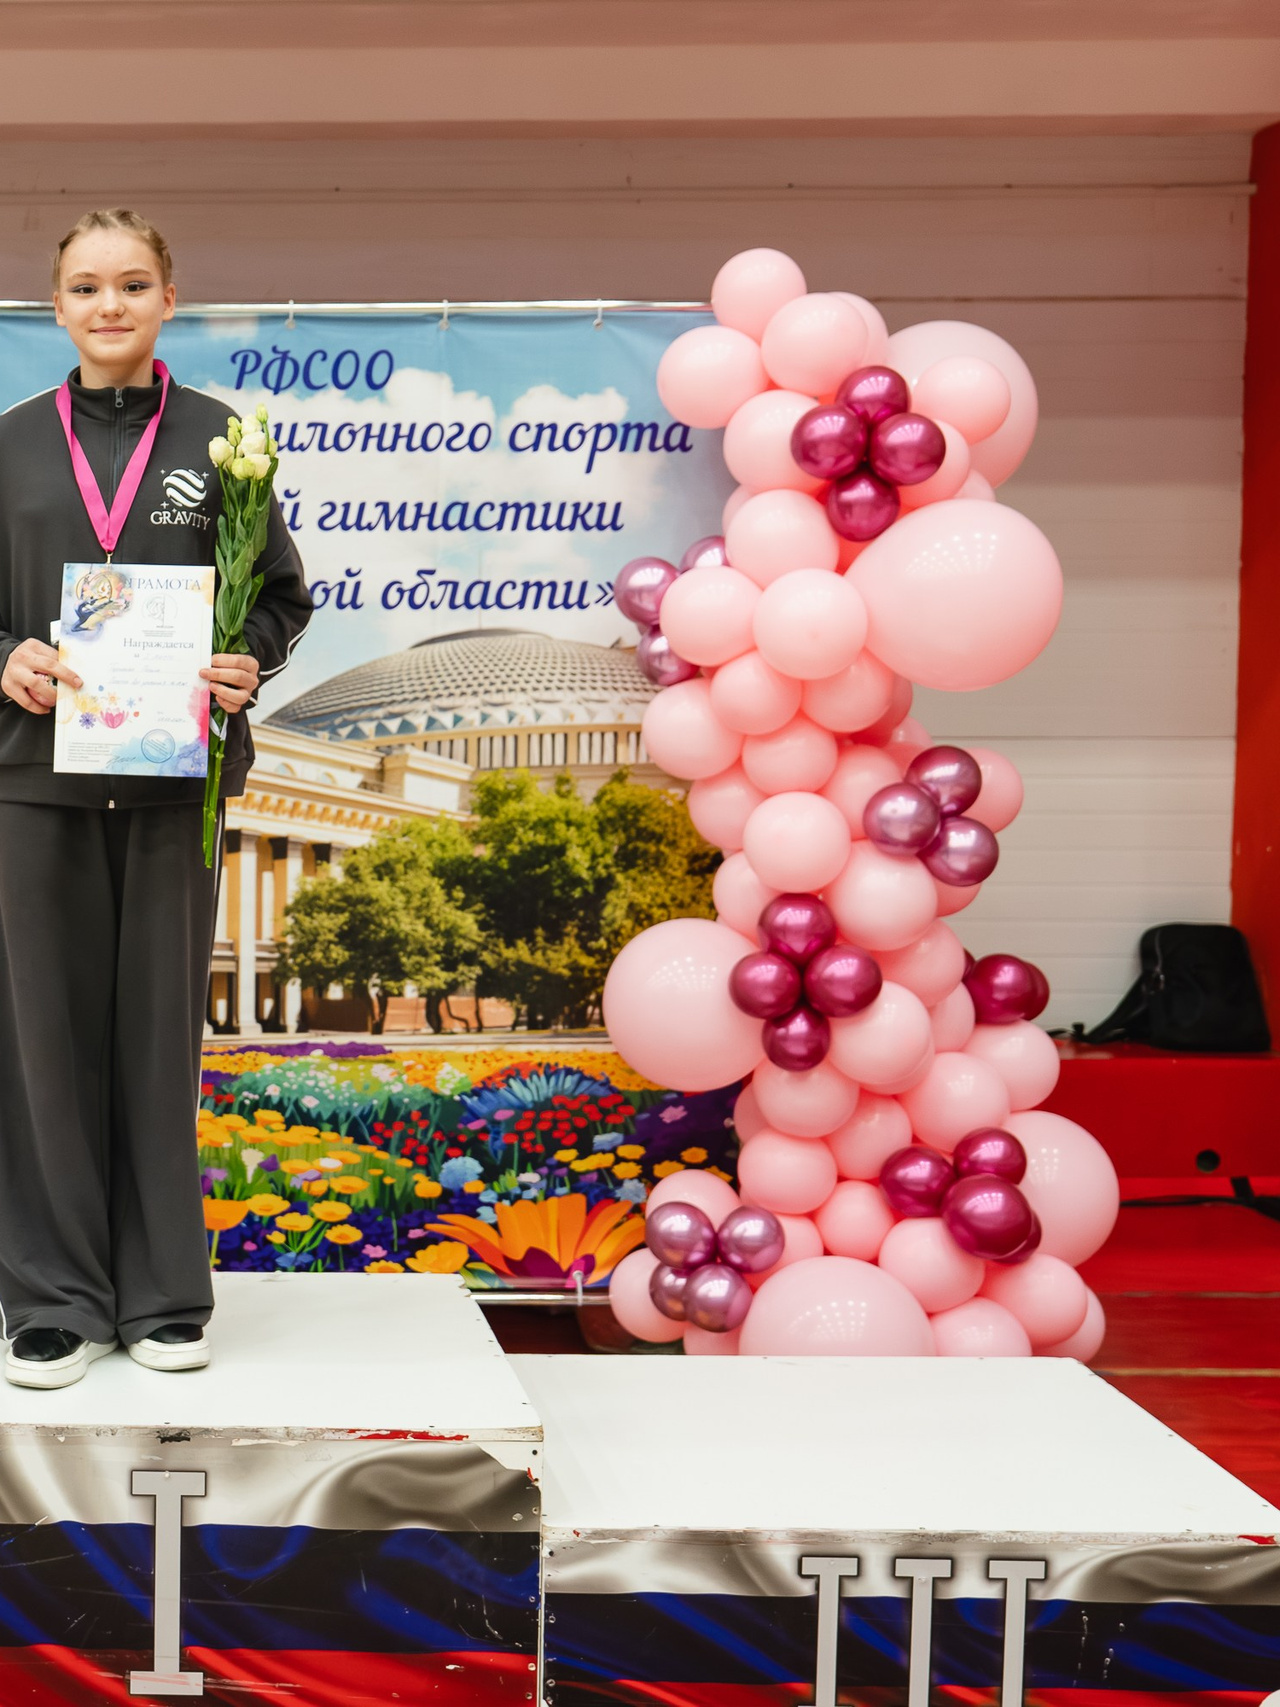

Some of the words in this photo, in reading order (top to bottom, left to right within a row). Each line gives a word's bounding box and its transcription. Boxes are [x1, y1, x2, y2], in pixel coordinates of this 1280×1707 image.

[230, 345, 395, 395] РФСОО
[273, 421, 492, 453] илонного
[508, 421, 694, 474] спорта
[150, 510, 211, 530] GRAVITY
[317, 500, 624, 532] гимнастики
[128, 577, 202, 591] ГРАМОТА
[123, 637, 195, 651] Награждается
